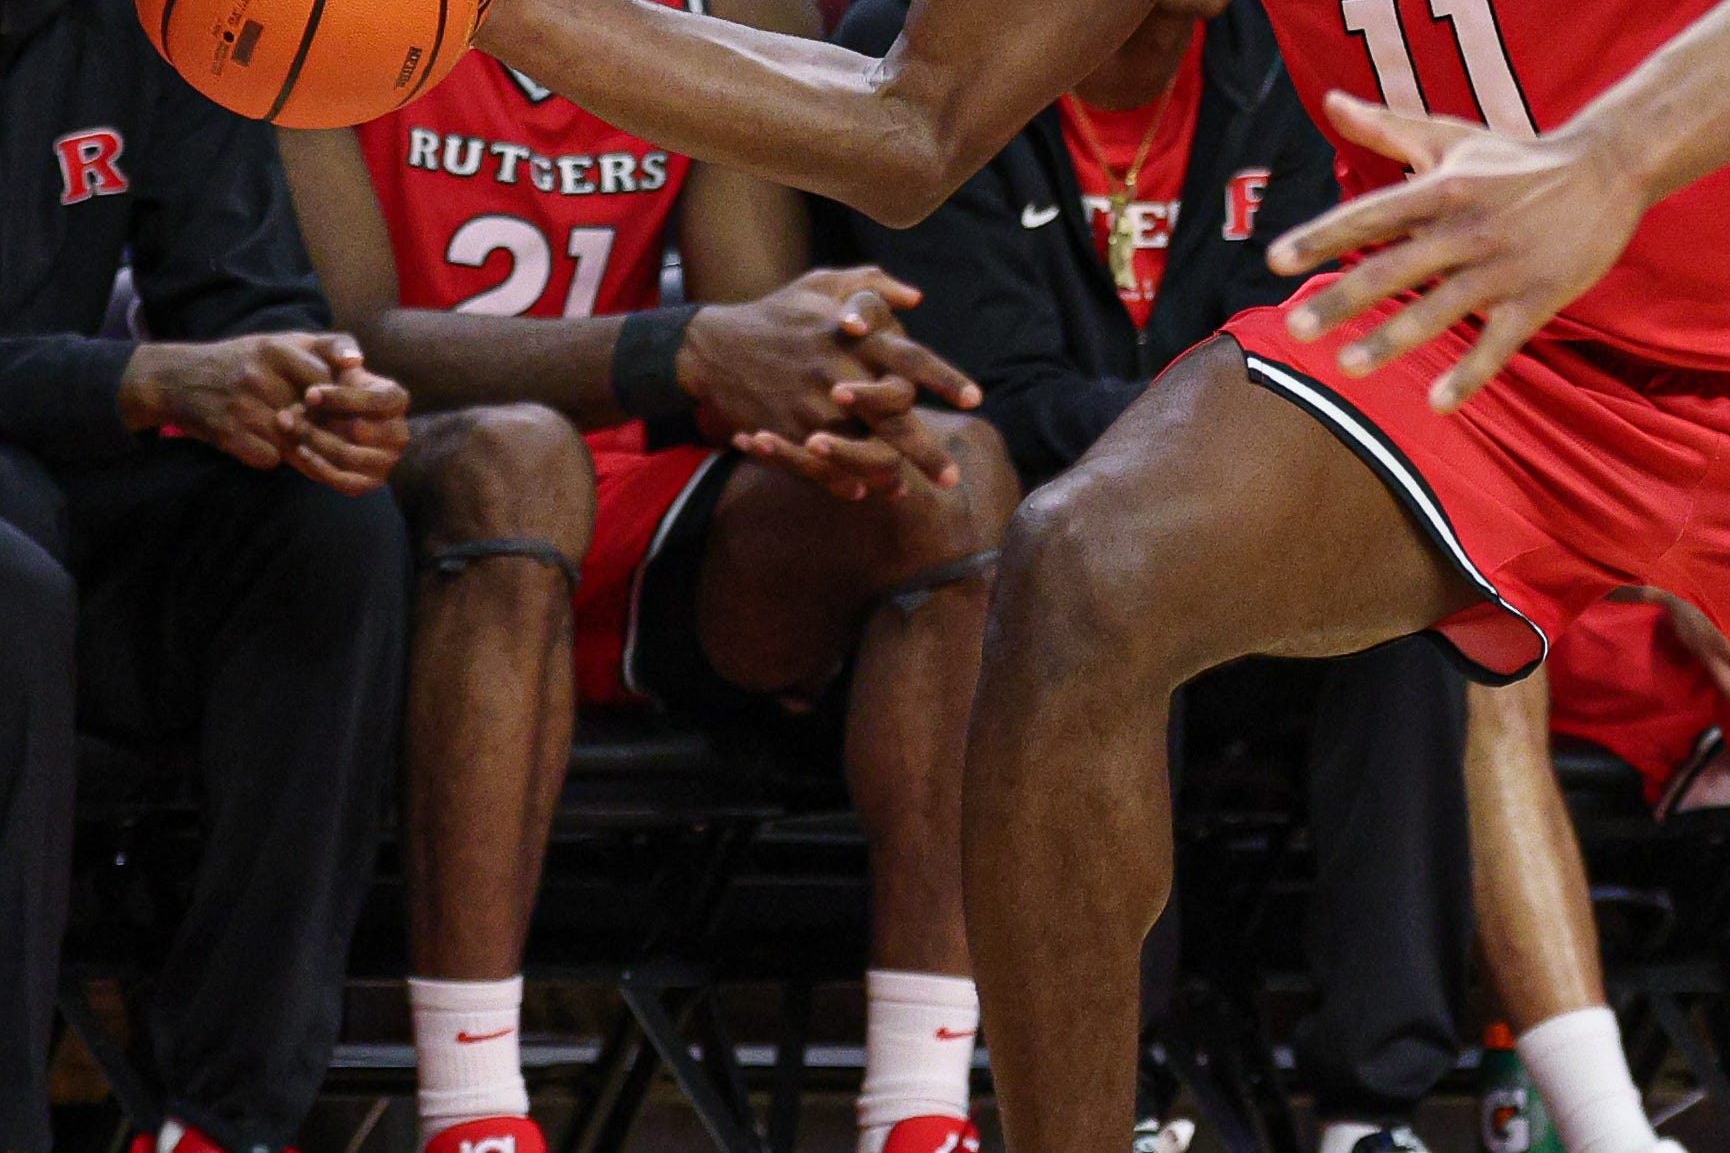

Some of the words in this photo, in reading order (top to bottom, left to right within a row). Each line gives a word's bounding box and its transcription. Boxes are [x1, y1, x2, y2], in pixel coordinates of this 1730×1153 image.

[53, 127, 129, 206] R
[407, 126, 671, 196] RUTGERS
[445, 214, 617, 318] 21
